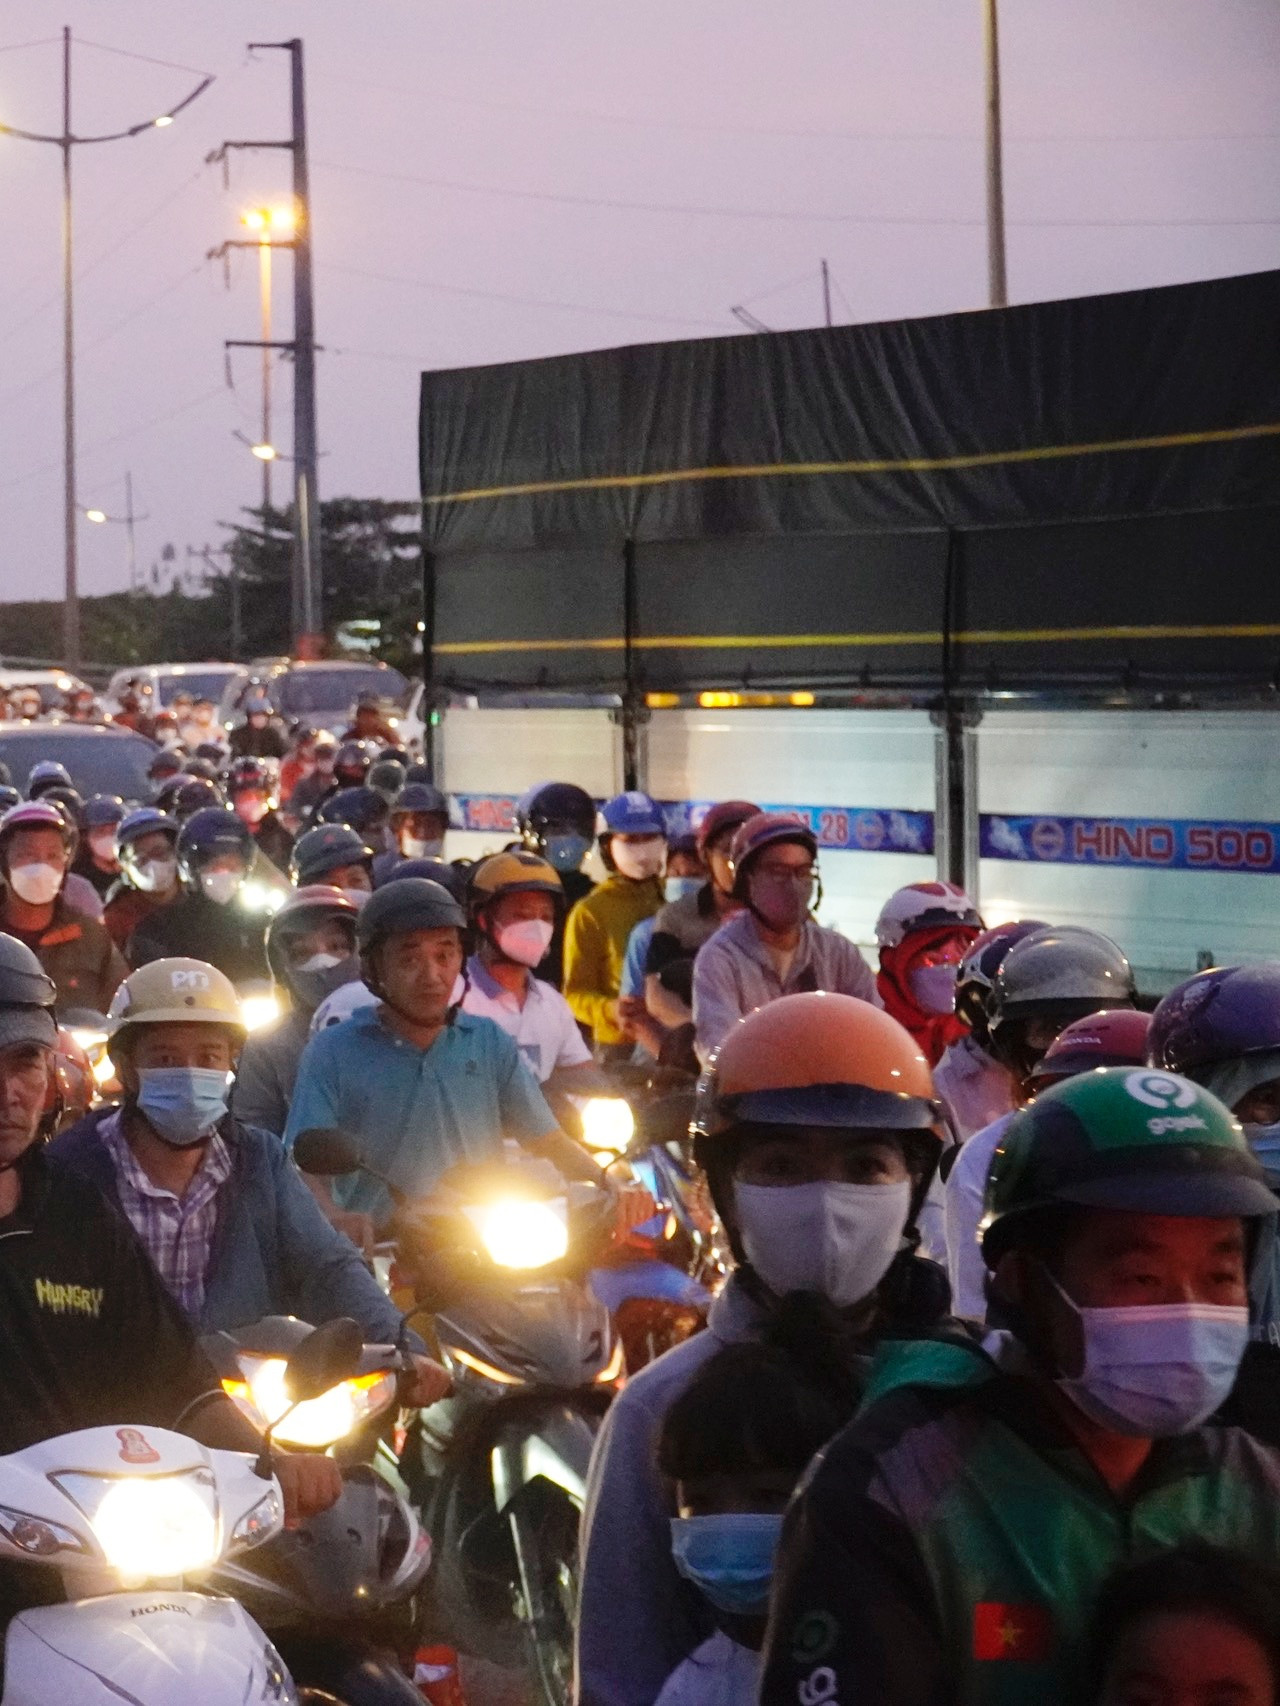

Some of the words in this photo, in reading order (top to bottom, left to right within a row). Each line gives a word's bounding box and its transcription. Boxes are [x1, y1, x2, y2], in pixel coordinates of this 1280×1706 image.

[1075, 823, 1174, 862] HINO
[1187, 828, 1273, 867] 500
[35, 1277, 104, 1318] HUNGRY
[131, 1603, 192, 1618] HONDA
